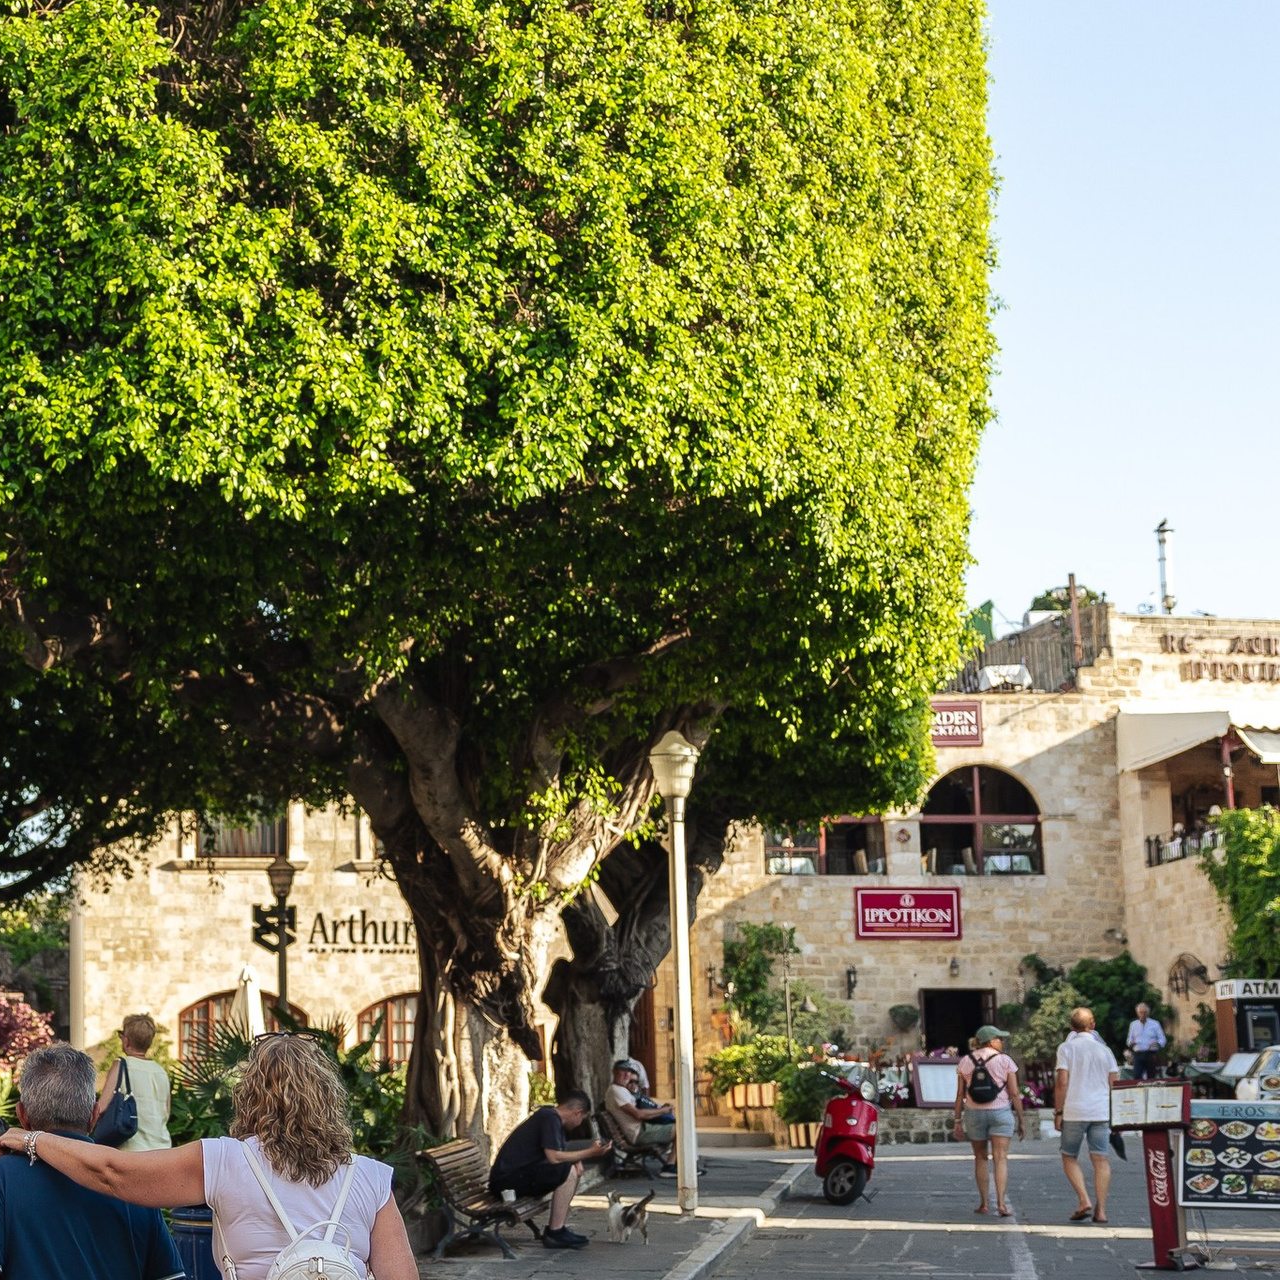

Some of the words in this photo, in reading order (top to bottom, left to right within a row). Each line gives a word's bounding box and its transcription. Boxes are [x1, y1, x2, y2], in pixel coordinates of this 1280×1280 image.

[931, 711, 976, 725] RDEN
[928, 725, 978, 736] CKTAILS
[864, 908, 951, 922] IPPOTIKON
[308, 909, 414, 945] Arthur
[1242, 982, 1279, 995] ATM
[1220, 1105, 1266, 1118] EROS
